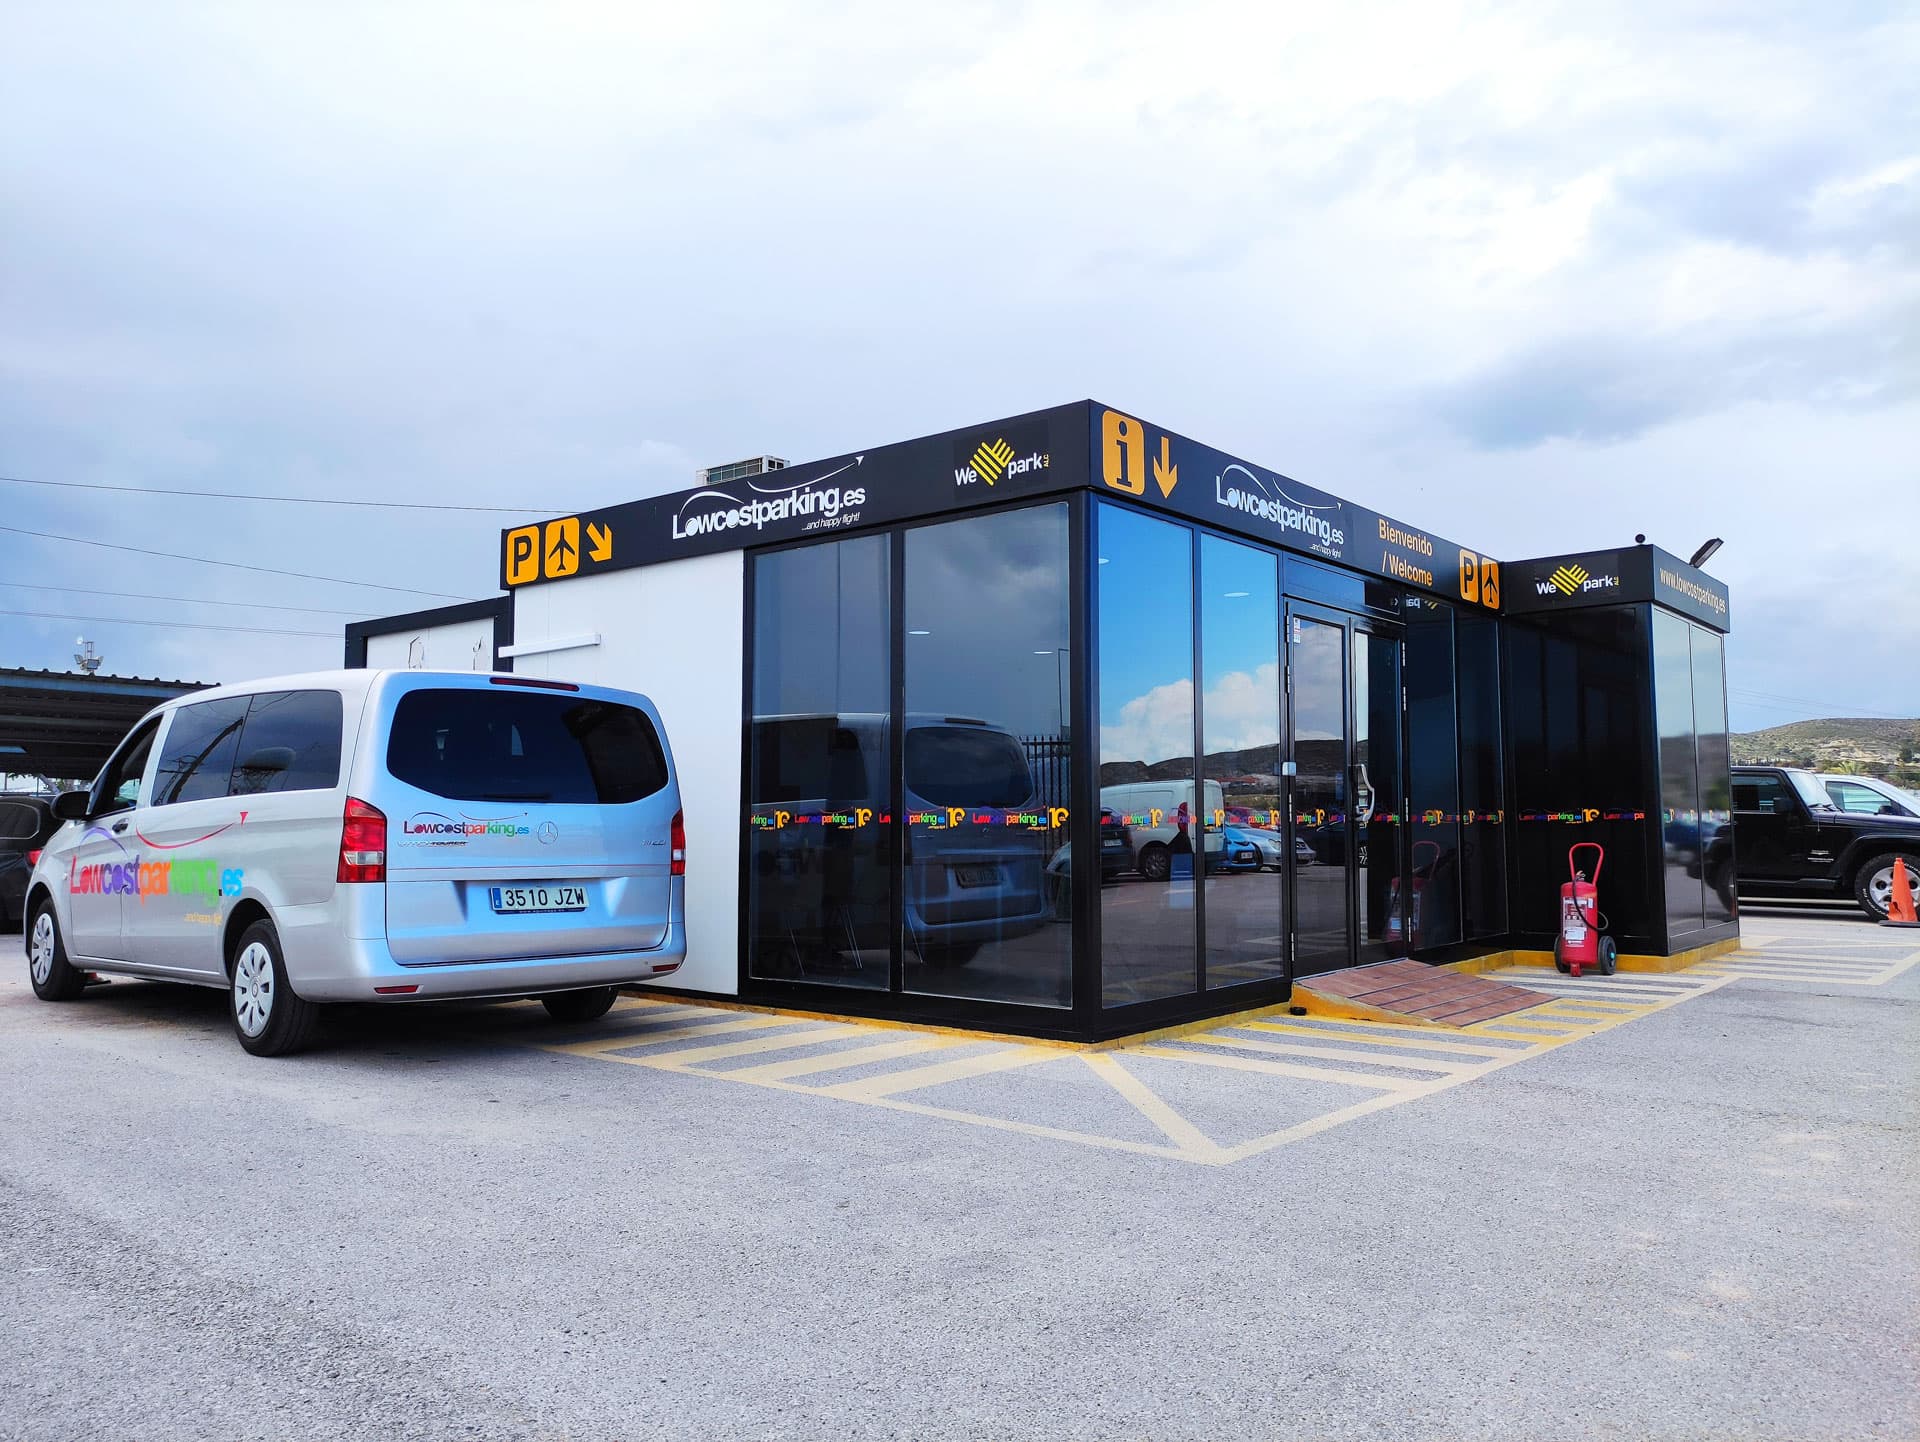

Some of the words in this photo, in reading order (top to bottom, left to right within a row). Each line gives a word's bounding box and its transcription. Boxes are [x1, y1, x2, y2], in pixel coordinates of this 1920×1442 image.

[954, 467, 978, 486] We
[1007, 452, 1043, 480] park
[672, 486, 866, 540] Lowcostparking.es
[1215, 475, 1344, 547] Lowcostparking.es
[513, 535, 532, 577] P
[1378, 518, 1433, 557] Bienvenido
[1389, 553, 1433, 587] Welcome
[1464, 555, 1475, 594] P
[1536, 582, 1557, 595] We
[1583, 575, 1614, 592] park
[1659, 567, 1726, 614] www.lowcostparking.es
[403, 820, 530, 837] Lowcostparking.es
[69, 854, 245, 908] Lowcostparking.es
[505, 889, 548, 907] 3510
[555, 888, 585, 906] JZW
